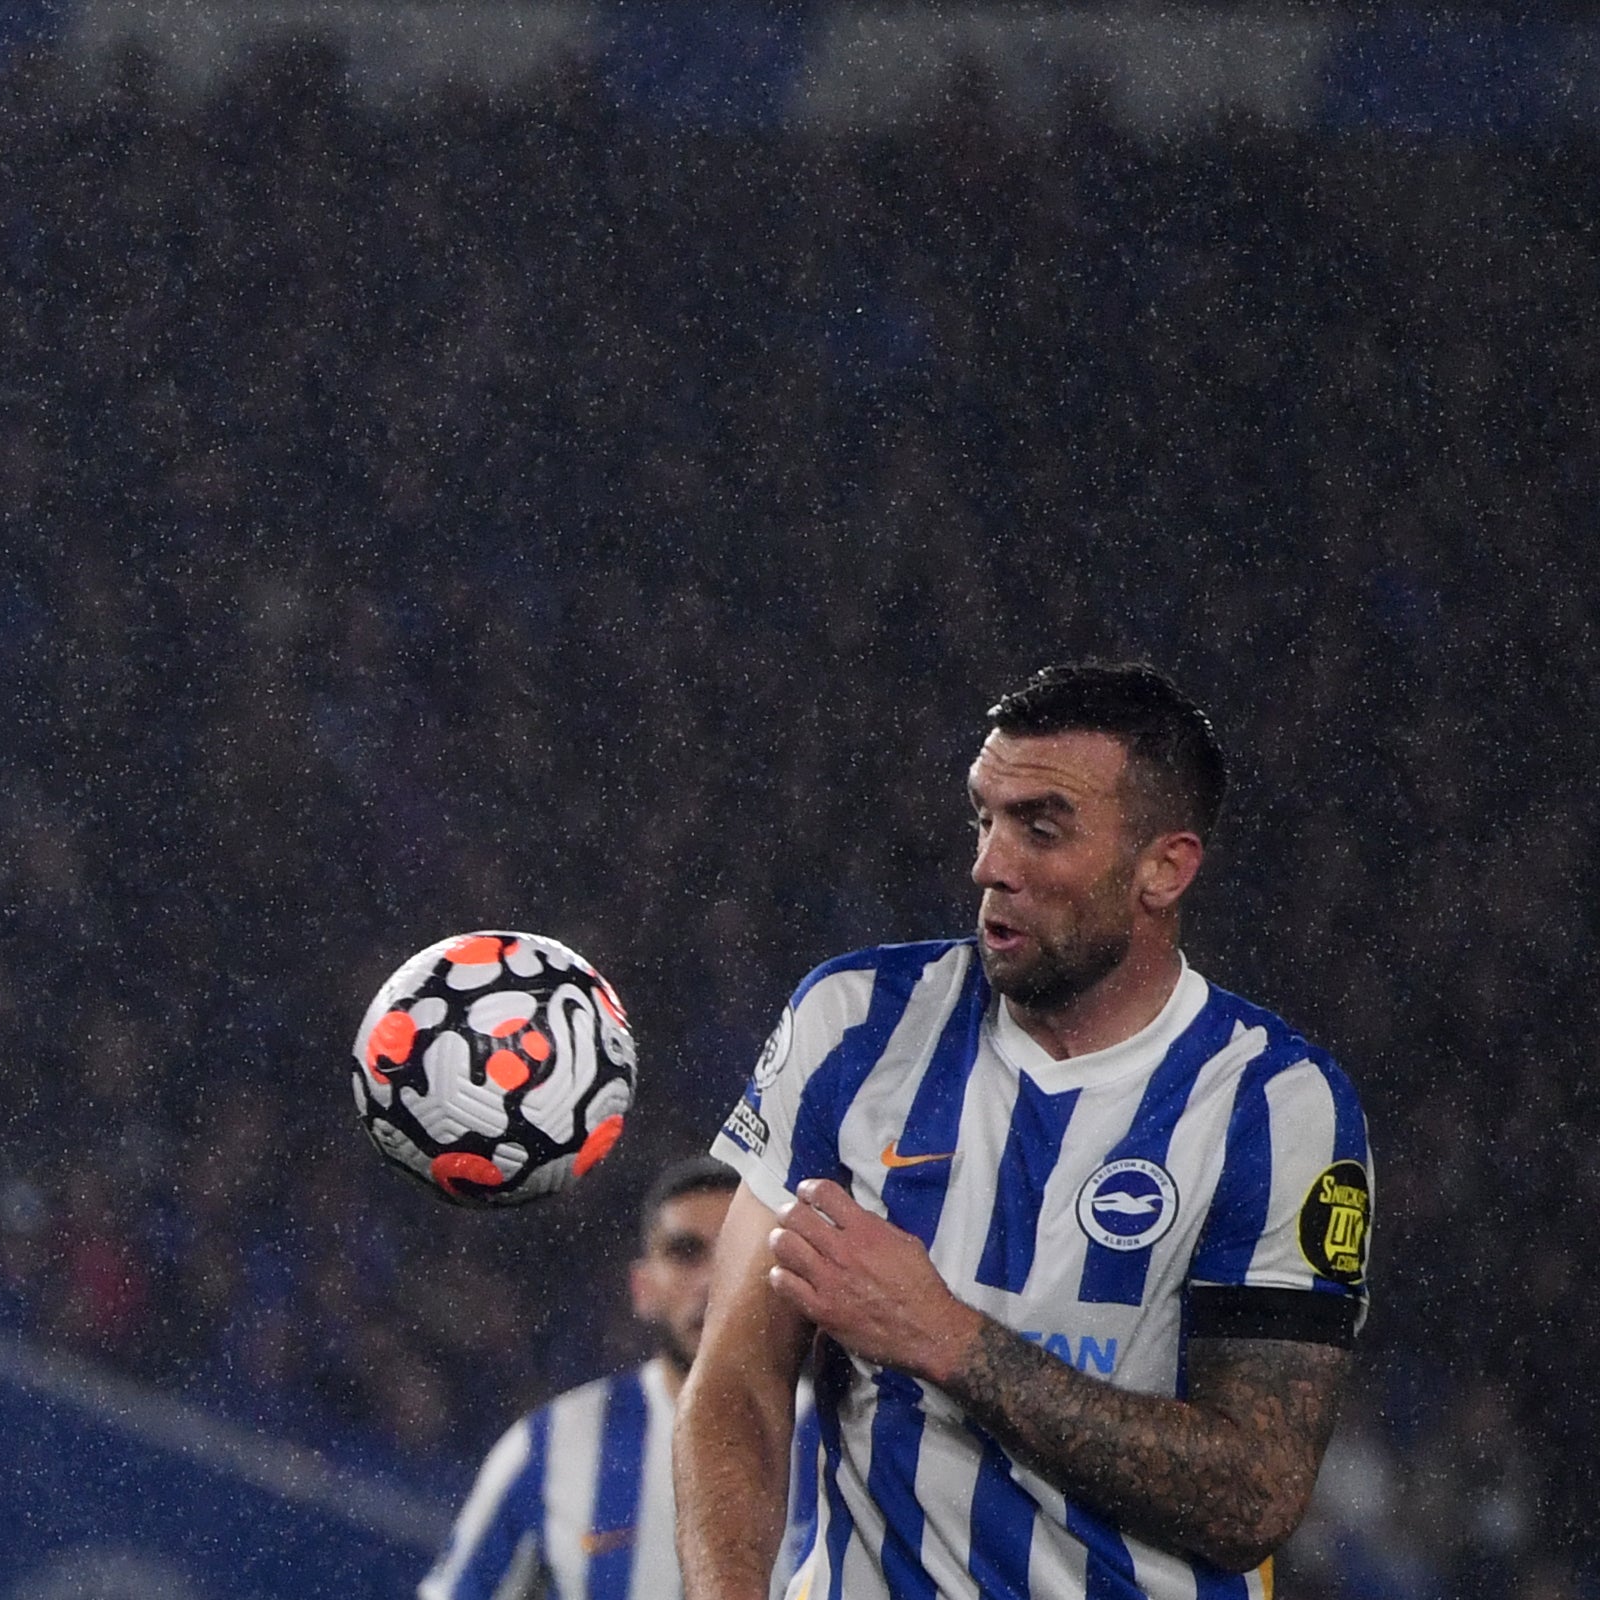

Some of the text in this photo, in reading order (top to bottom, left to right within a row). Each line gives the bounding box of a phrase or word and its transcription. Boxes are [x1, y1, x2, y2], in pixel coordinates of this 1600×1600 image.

[1092, 1162, 1137, 1185] BRIGHTON
[1150, 1167, 1168, 1187] HOVE
[1103, 1235, 1141, 1247] ALBION
